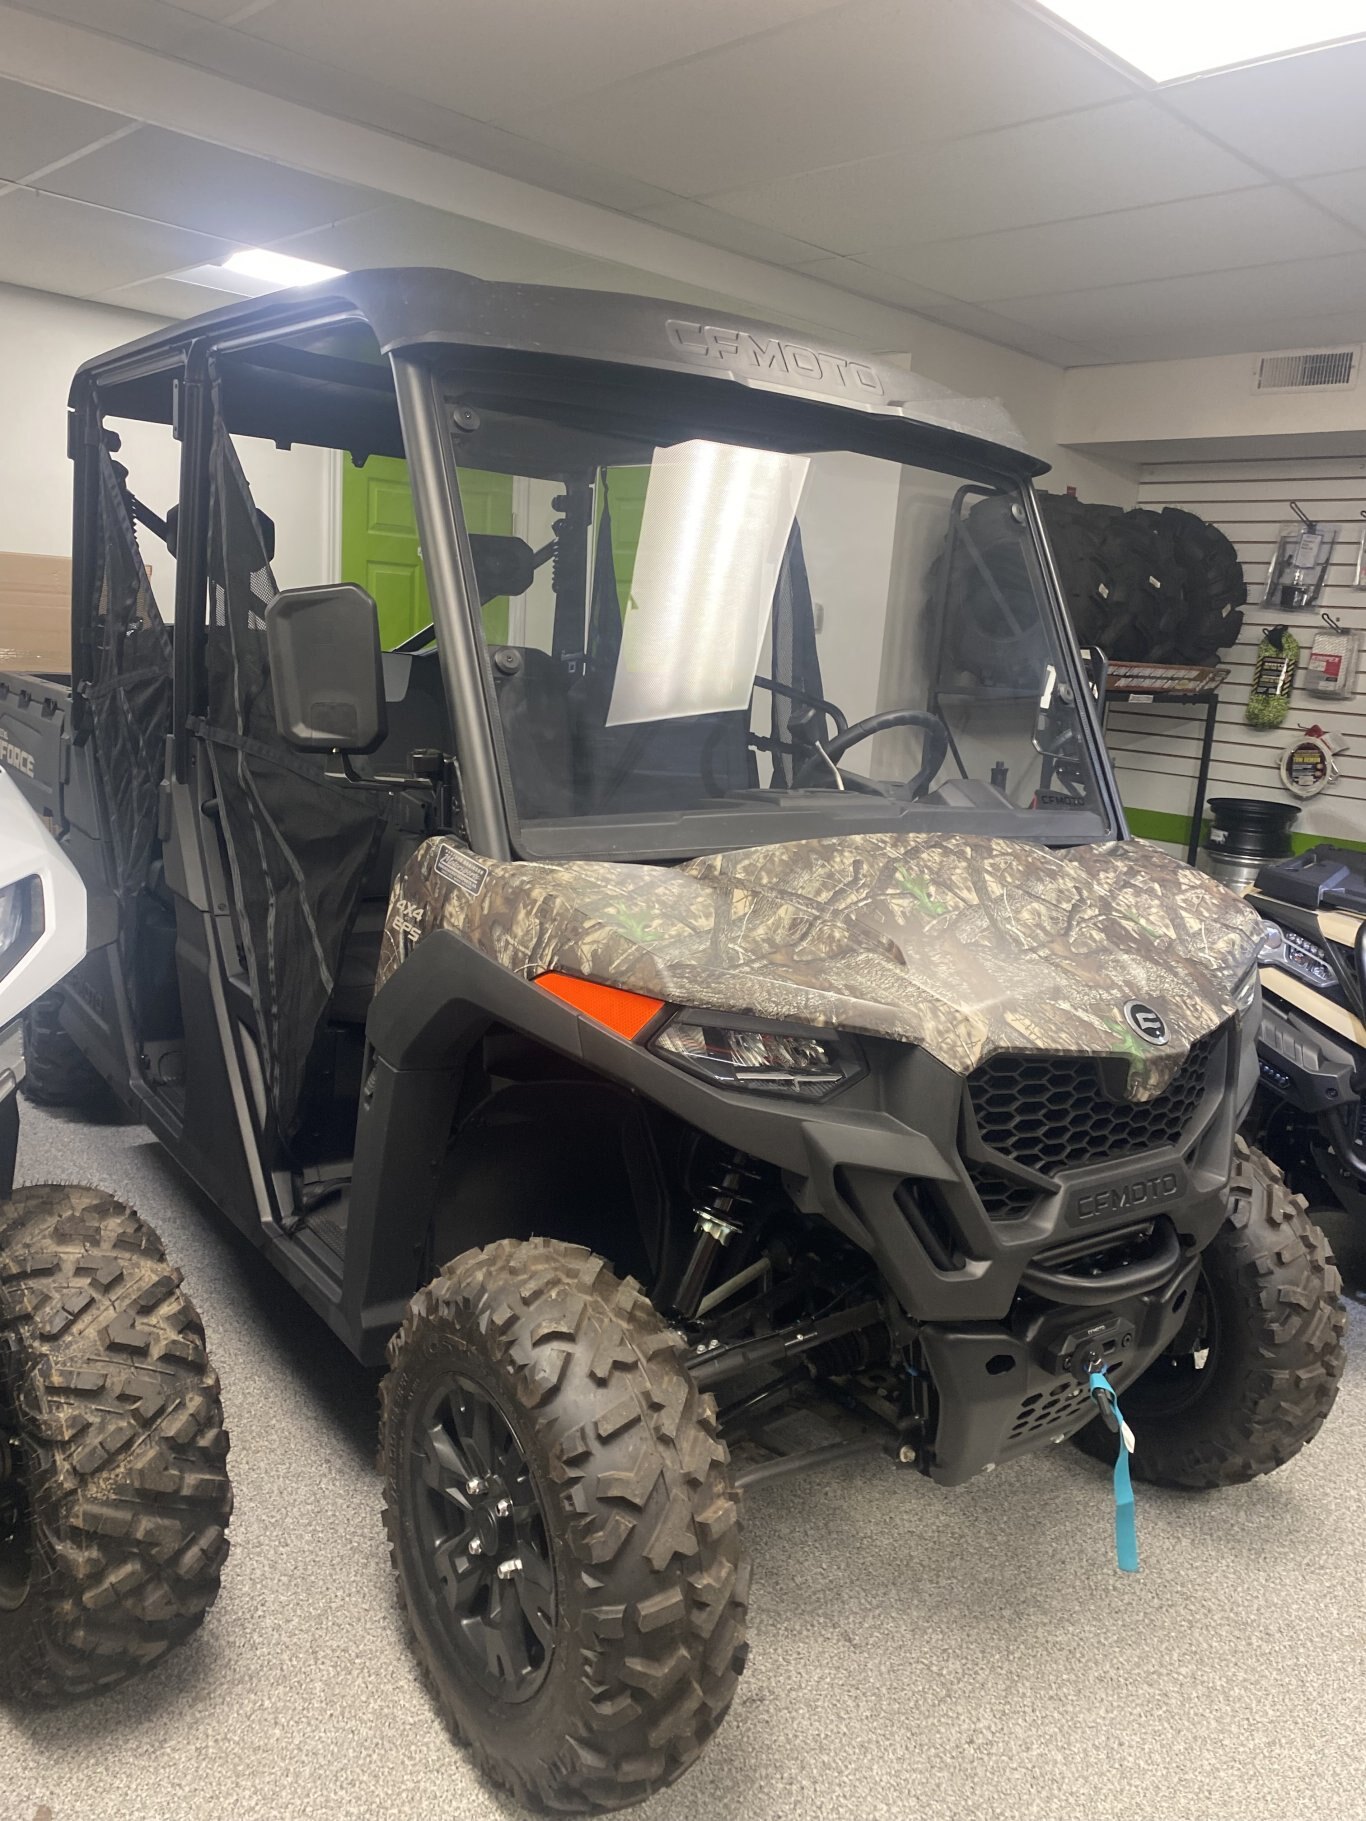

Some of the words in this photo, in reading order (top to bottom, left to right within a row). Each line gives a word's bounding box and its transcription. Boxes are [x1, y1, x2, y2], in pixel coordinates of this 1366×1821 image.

[665, 319, 885, 396] CFMOTO
[392, 916, 422, 942] EPS
[1077, 1172, 1178, 1220] CFMOTO
